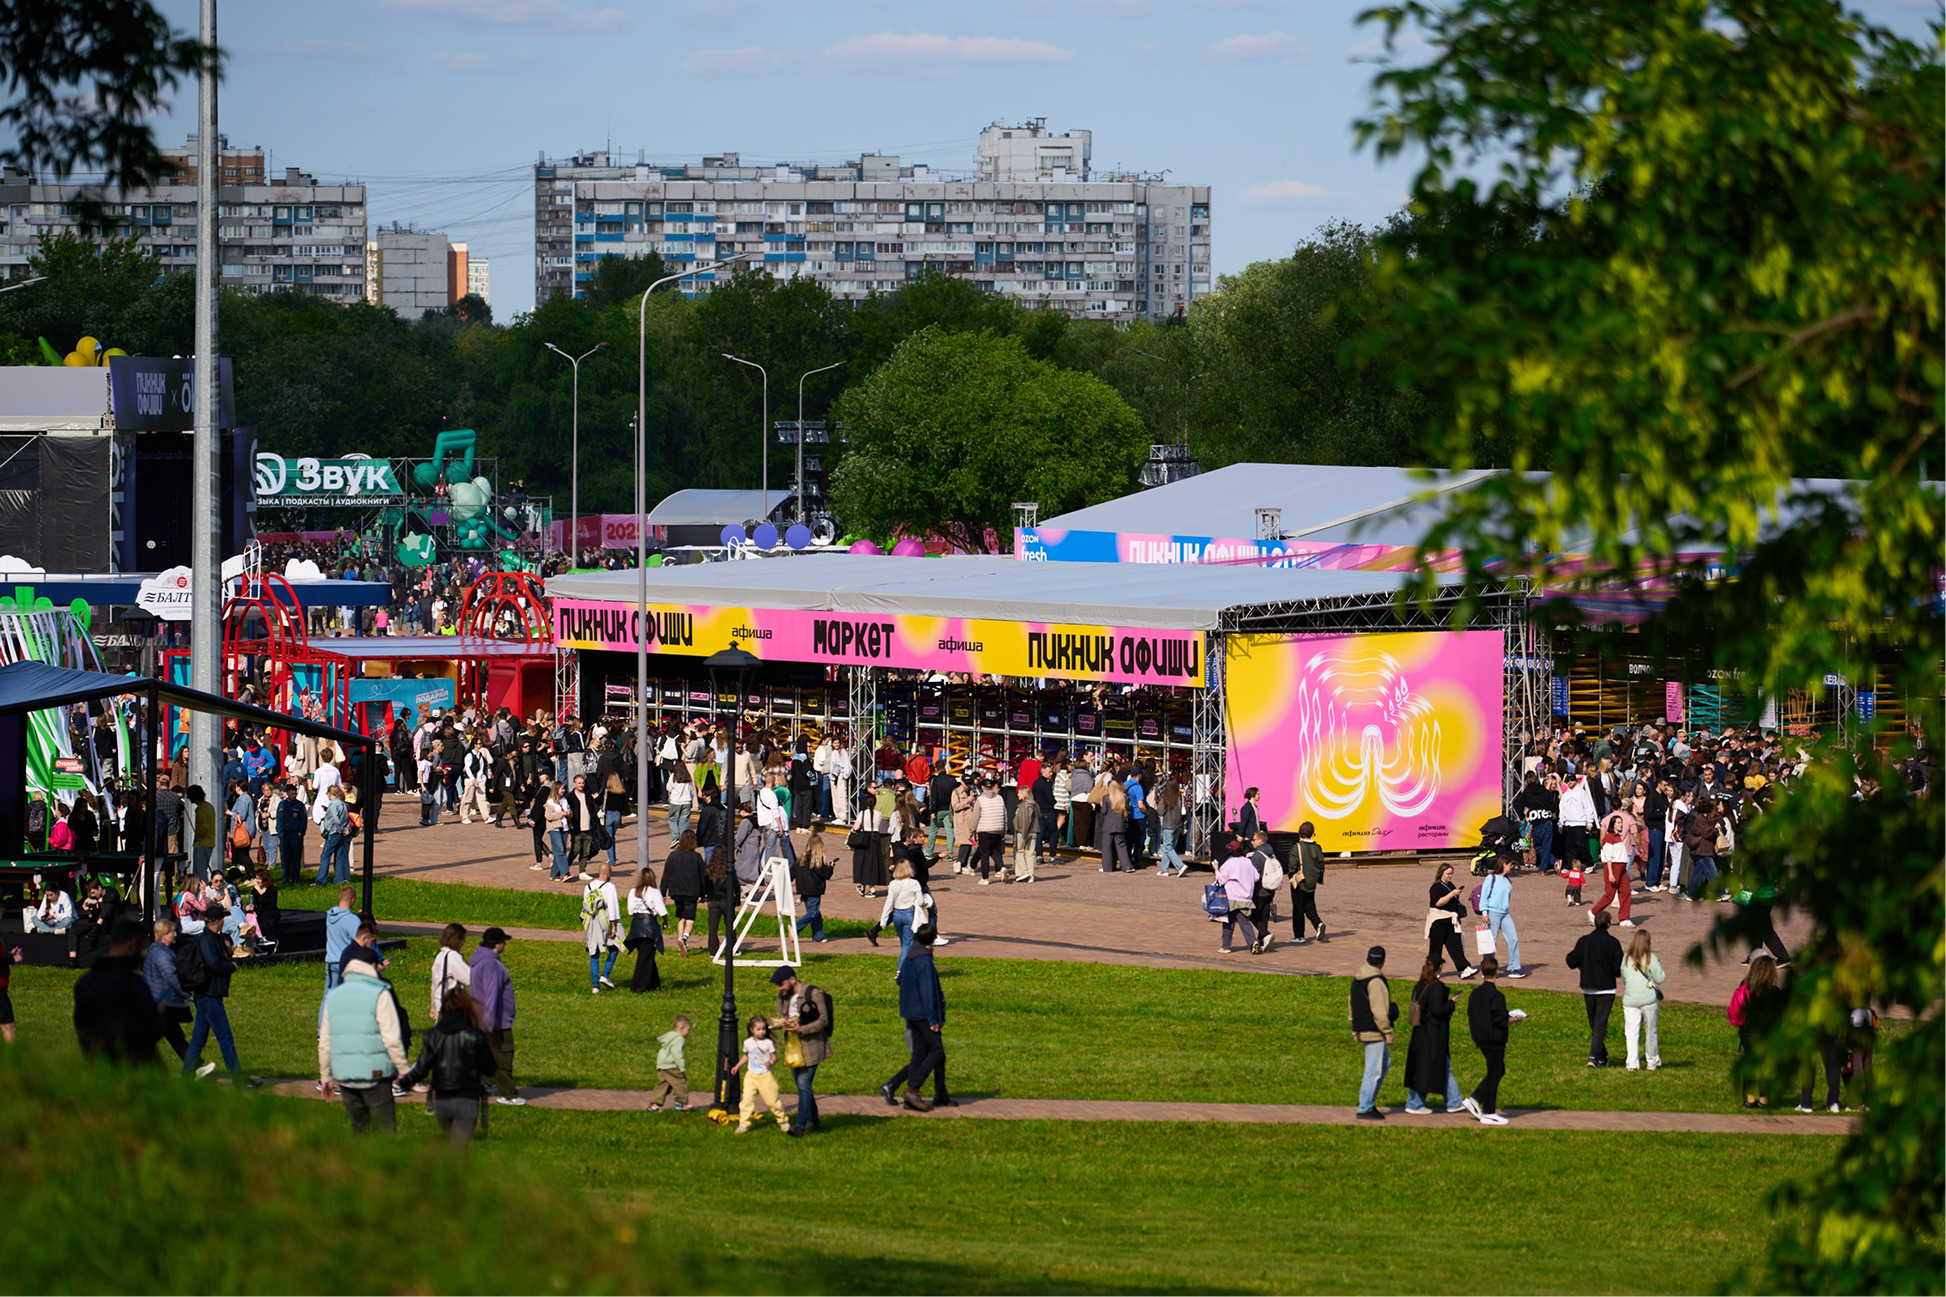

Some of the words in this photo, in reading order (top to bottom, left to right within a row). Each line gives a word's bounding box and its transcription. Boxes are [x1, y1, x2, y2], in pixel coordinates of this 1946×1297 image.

[296, 457, 390, 496] Звук
[286, 498, 330, 506] ПОДКАСТЫ
[606, 523, 640, 540] 202
[1020, 534, 1039, 544] OZON
[1020, 545, 1047, 561] fresh
[1129, 540, 1200, 564] ПИКНИК
[156, 592, 192, 603] БАЛТ
[559, 607, 627, 643] ПИКНИК
[732, 624, 772, 641] афиша
[813, 619, 895, 658] МАРКЕТ
[938, 636, 983, 654] афиша
[1028, 632, 1114, 673] ПИКНИК
[1120, 636, 1198, 677] АФИШИ
[1733, 667, 1747, 680] fre
